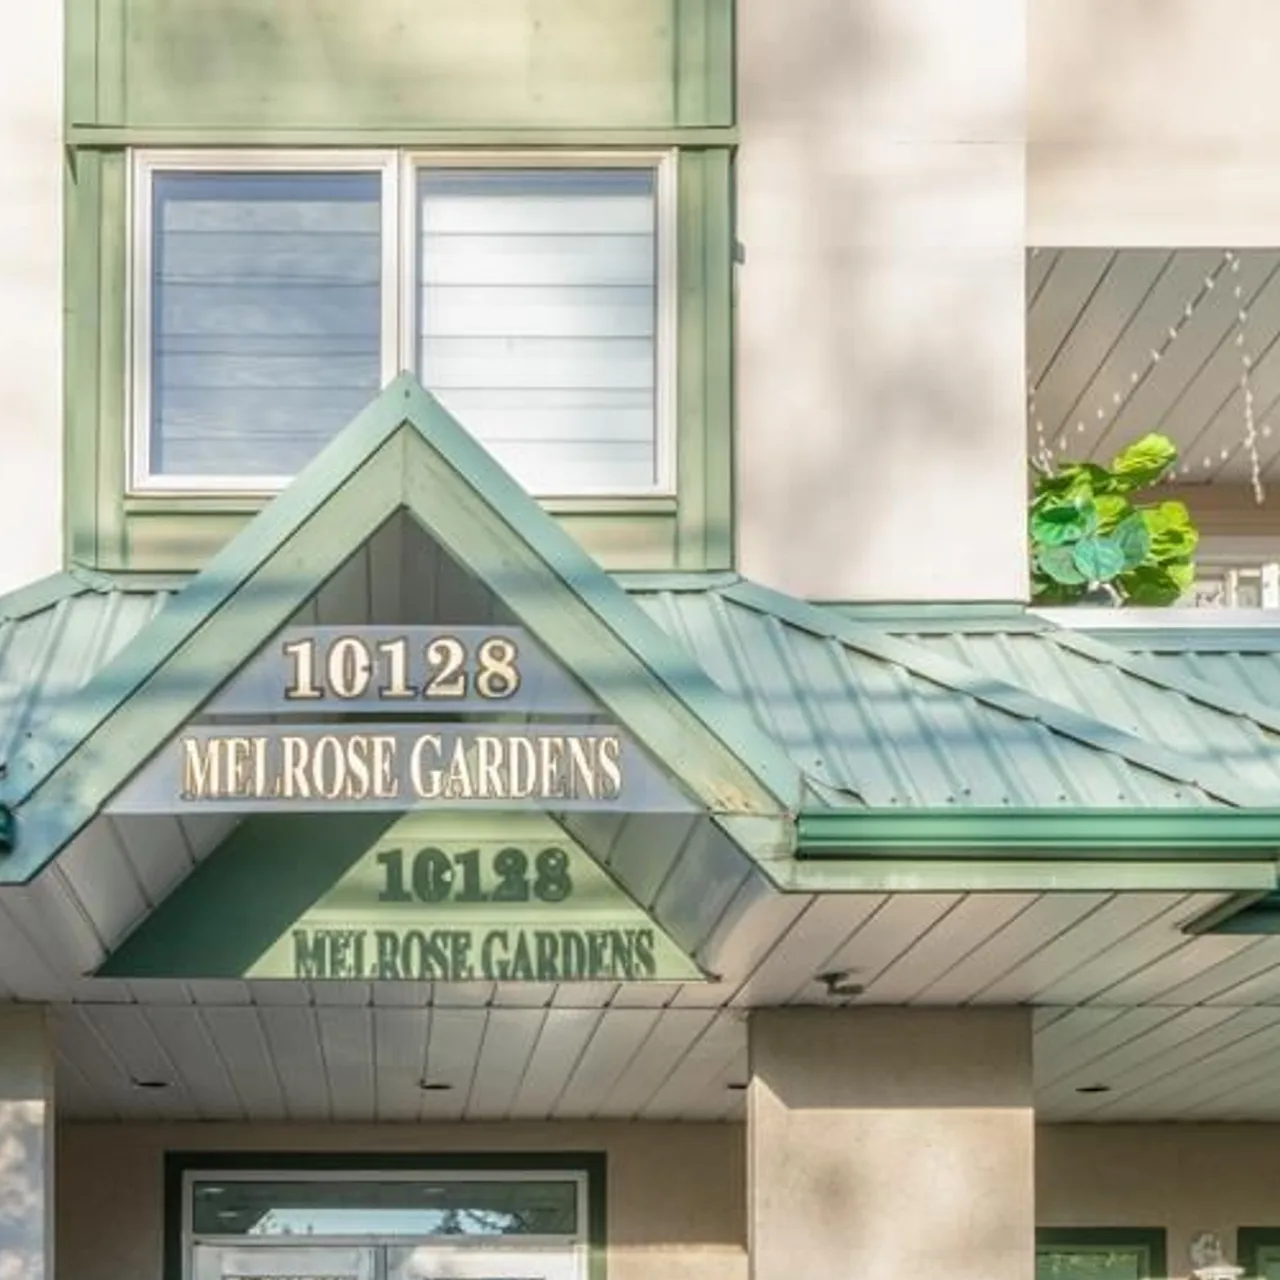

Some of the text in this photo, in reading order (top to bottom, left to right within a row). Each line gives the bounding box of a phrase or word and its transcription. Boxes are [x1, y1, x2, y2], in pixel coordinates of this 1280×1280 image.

[284, 635, 521, 700] 10128
[181, 733, 622, 800] MELROSE GARDENS
[377, 846, 573, 902] 10128
[292, 928, 657, 980] MELROSE GARDENS
